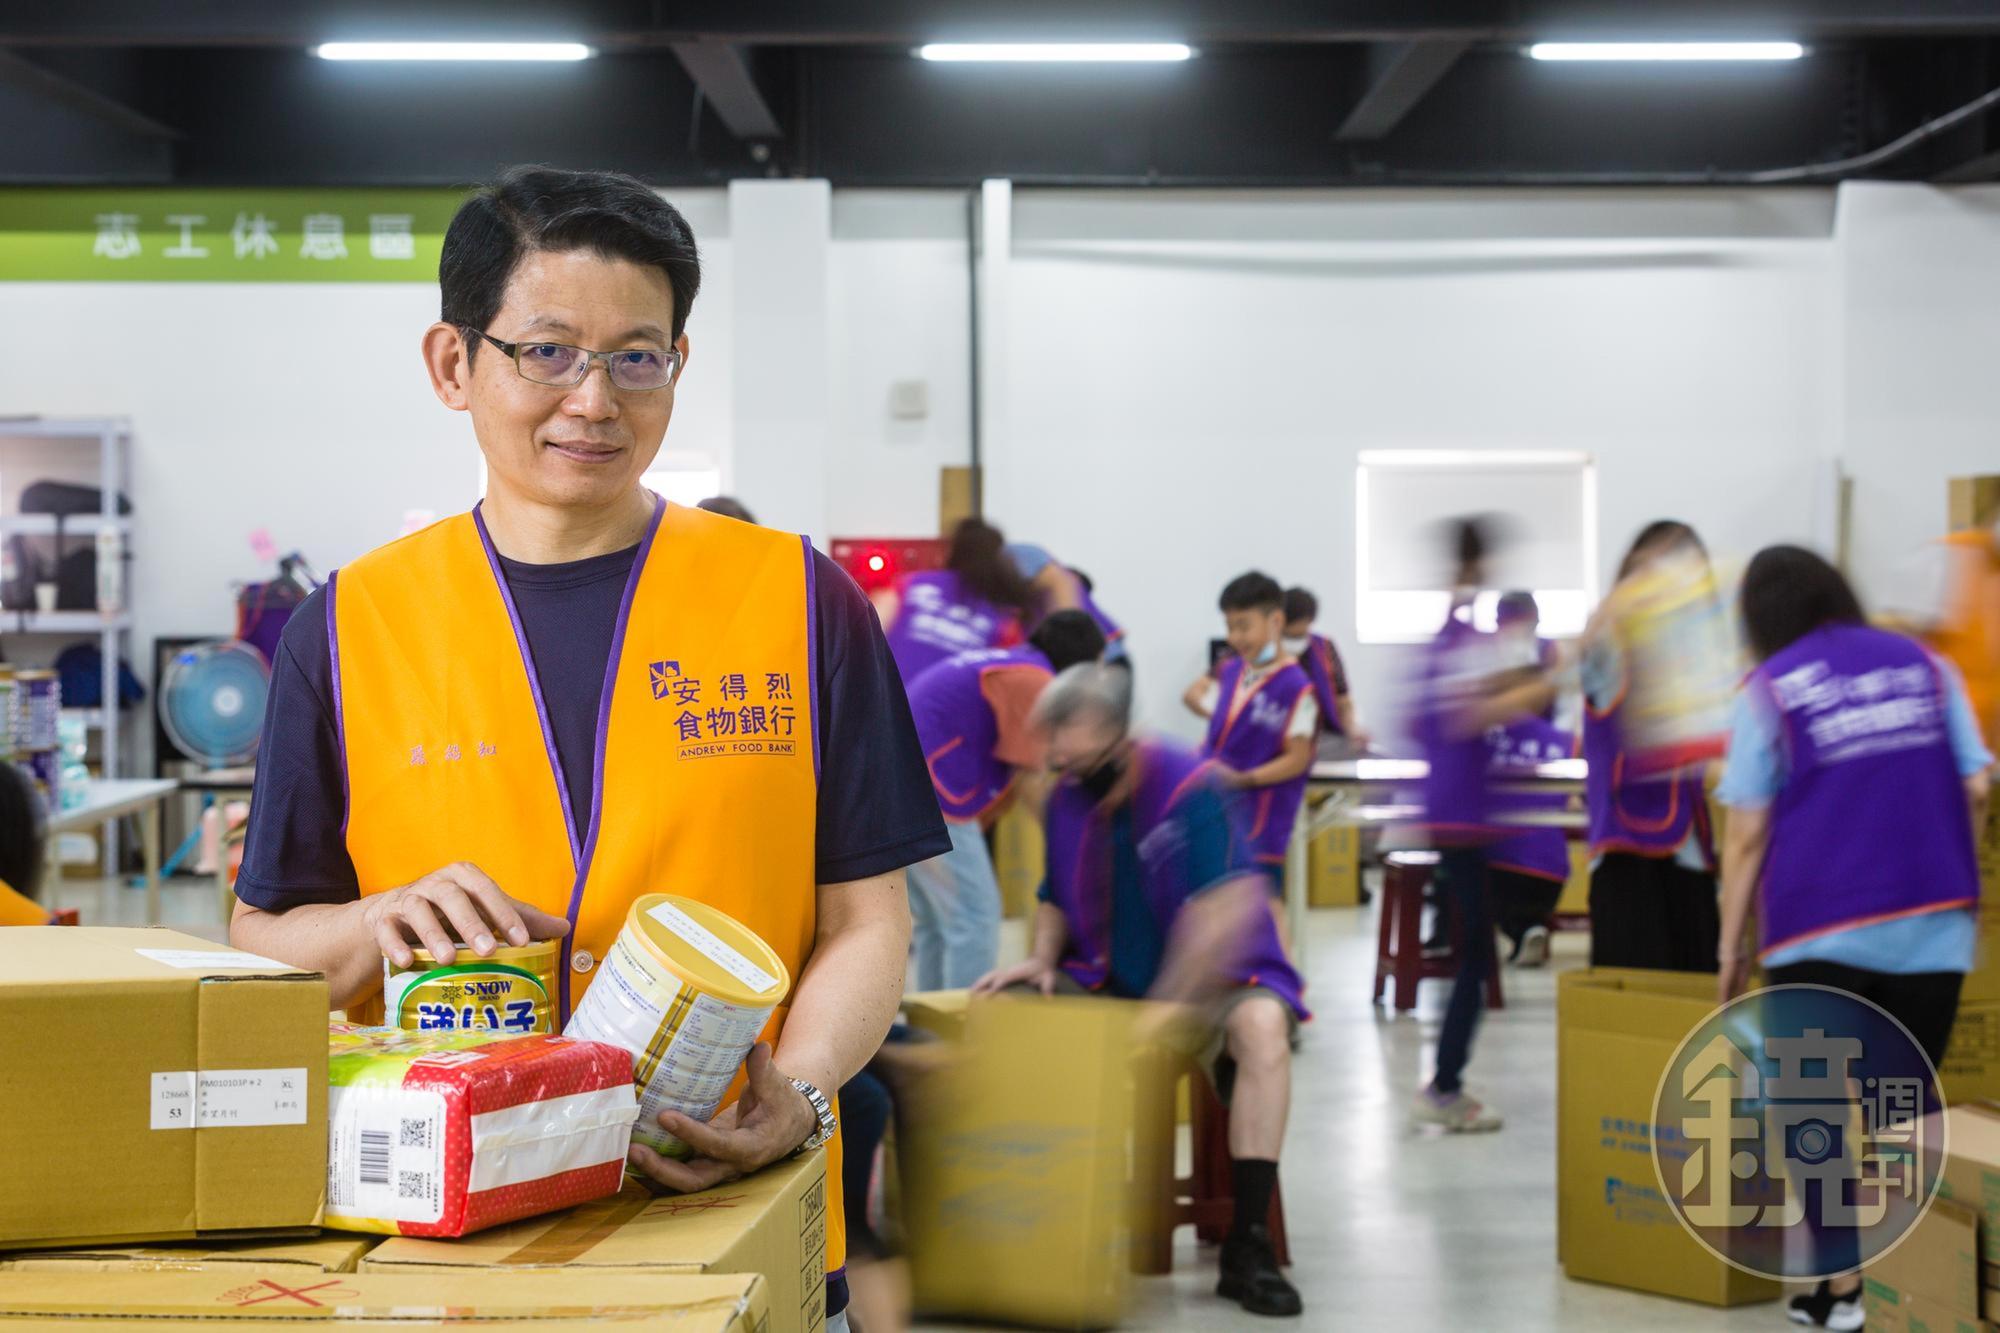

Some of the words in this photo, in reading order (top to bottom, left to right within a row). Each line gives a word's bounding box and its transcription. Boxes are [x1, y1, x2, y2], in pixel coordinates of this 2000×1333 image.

[94, 212, 416, 260] 志工休息區
[673, 673, 793, 706] 安得烈
[674, 705, 796, 742] 食物銀行
[680, 744, 726, 758] ANDREW
[733, 743, 763, 753] FOOD
[768, 743, 793, 753] BANK
[464, 980, 513, 996] SNOW
[281, 1080, 294, 1089] XL
[169, 1108, 183, 1119] 53
